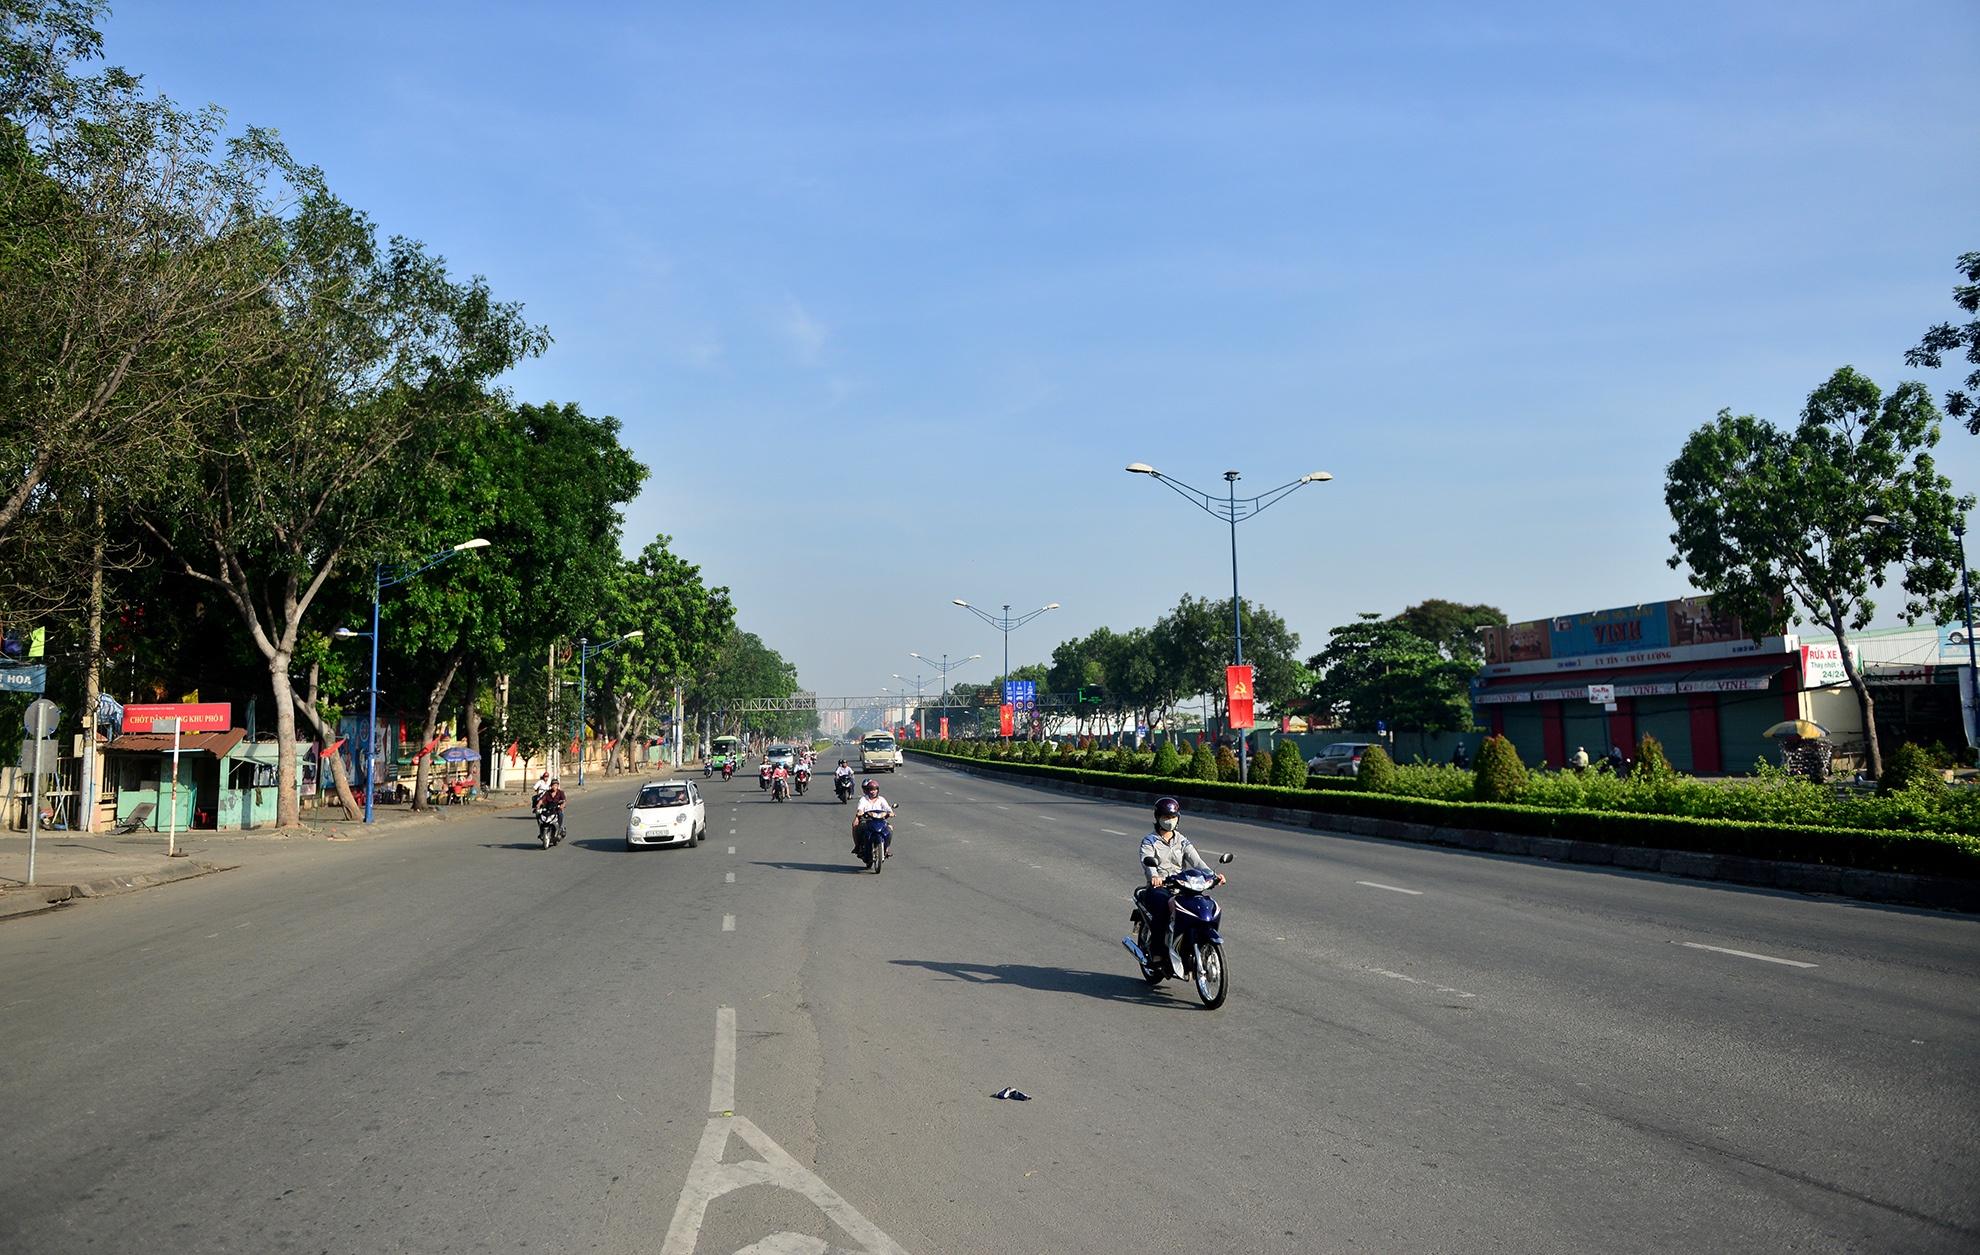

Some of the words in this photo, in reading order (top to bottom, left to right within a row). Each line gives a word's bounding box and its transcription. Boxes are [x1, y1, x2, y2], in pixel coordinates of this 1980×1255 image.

[1592, 621, 1642, 644] VINH
[1809, 647, 1825, 660] RỬA
[1827, 650, 1837, 660] XE
[1822, 670, 1845, 678] 24/24
[1717, 680, 1748, 690] VINH
[1561, 689, 1583, 698] VINH
[1632, 686, 1658, 695] VINH
[1498, 694, 1518, 703] VINH
[189, 715, 204, 723] KHU
[219, 714, 224, 722] 8
